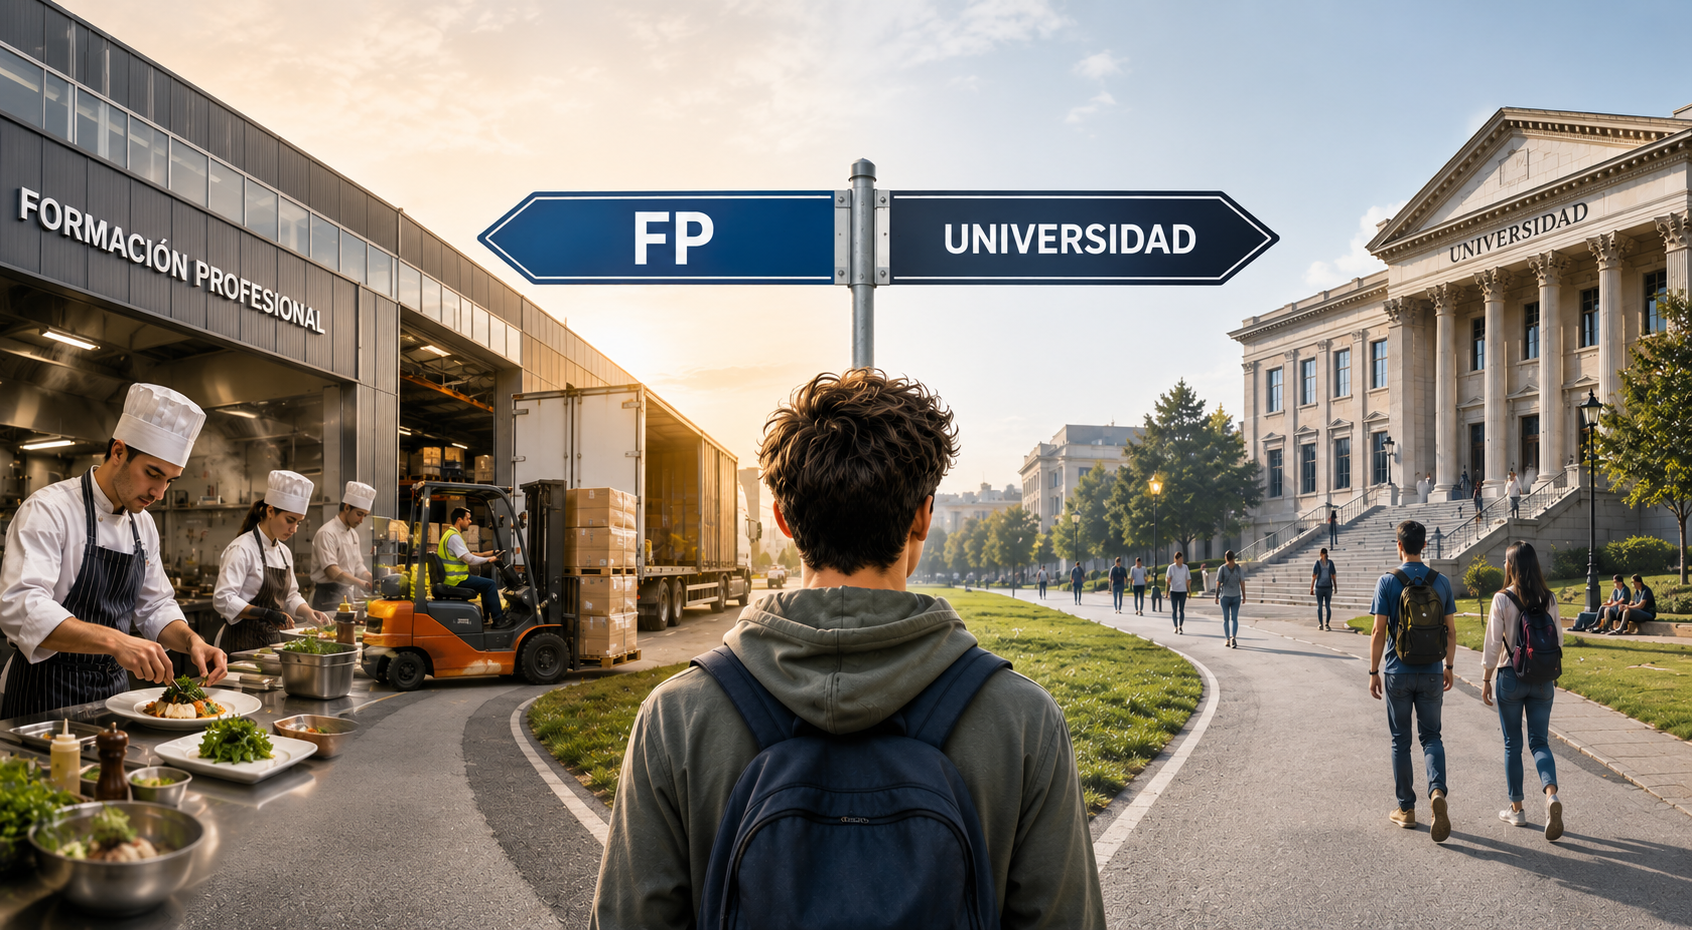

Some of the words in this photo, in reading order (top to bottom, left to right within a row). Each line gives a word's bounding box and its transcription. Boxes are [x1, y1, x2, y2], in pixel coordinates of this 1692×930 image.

[19, 186, 189, 281] FORMACIÓN
[194, 258, 326, 334] PROFESIONAL
[634, 211, 714, 265] FP
[944, 223, 1197, 255] UNIVERSIDAD
[1449, 202, 1589, 263] UNIVERSIDAD
